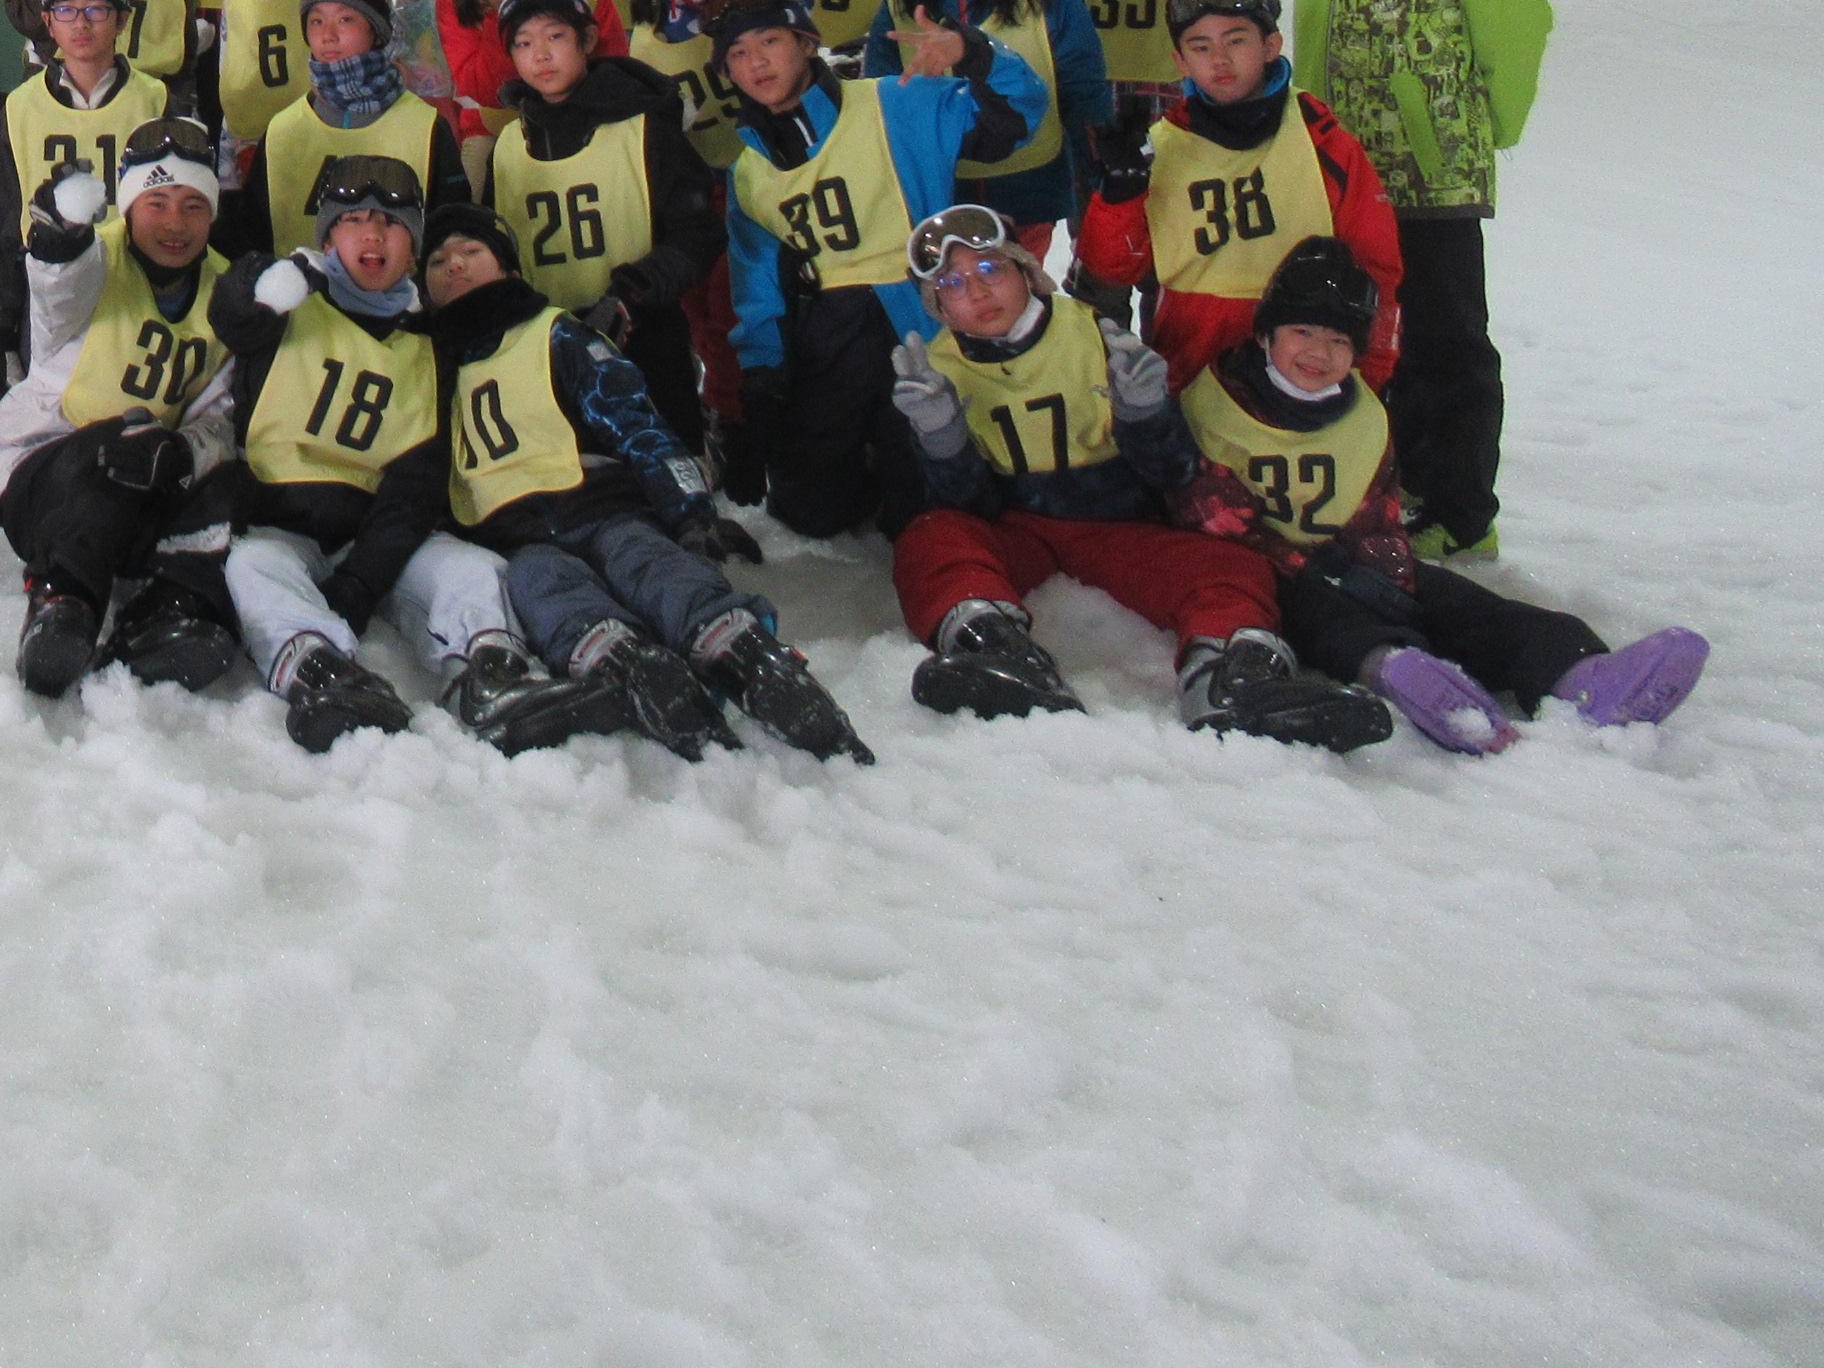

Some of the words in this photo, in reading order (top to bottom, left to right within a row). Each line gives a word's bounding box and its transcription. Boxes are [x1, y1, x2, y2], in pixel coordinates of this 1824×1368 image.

[257, 24, 289, 87] 6
[525, 183, 606, 267] 26
[779, 176, 861, 258] 39
[1188, 168, 1276, 255] 38
[121, 319, 207, 405] 30
[306, 357, 394, 452] 18
[990, 393, 1069, 473] 17
[1248, 453, 1341, 534] 32
